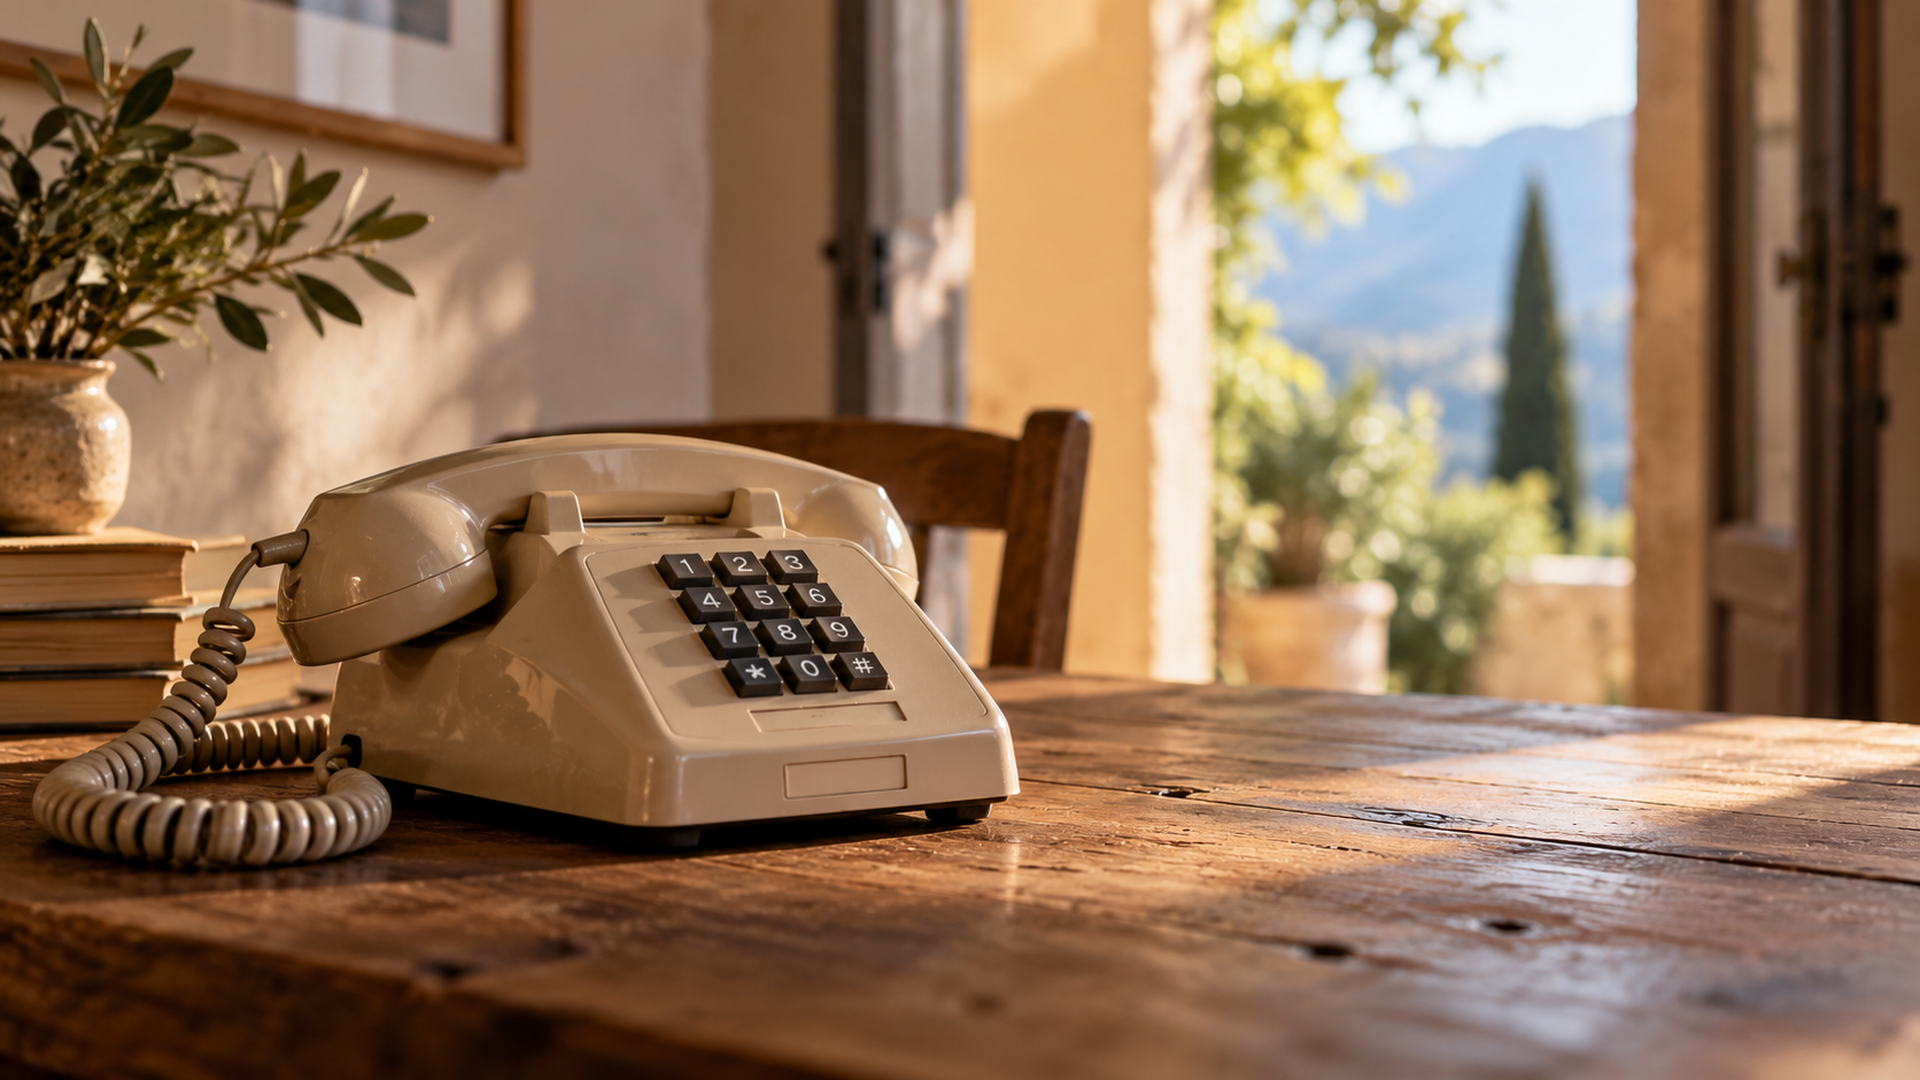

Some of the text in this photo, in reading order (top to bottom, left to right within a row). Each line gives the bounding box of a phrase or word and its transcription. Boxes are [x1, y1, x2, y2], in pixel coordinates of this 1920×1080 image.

[680, 555, 804, 574] 1 2 3
[702, 587, 827, 608] 4 5 6
[721, 621, 849, 644] 7 8 9
[800, 660, 820, 677] 0
[852, 657, 874, 674] #
